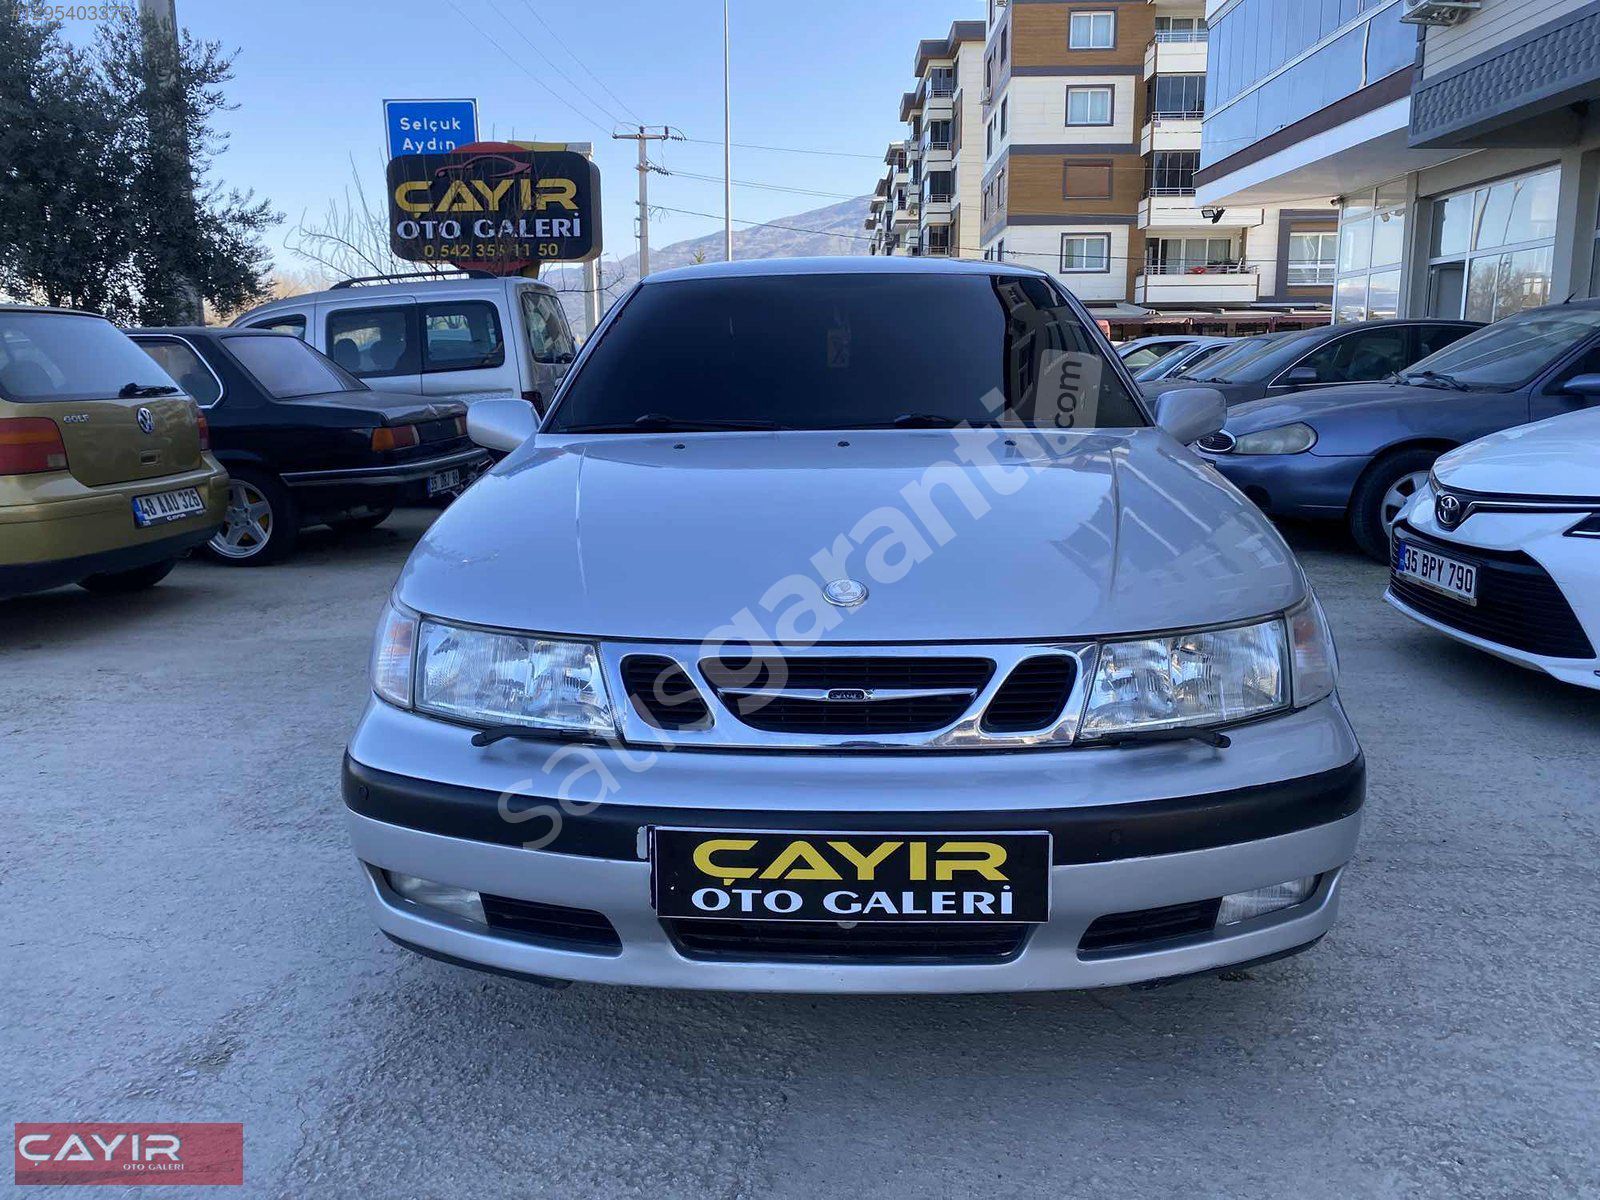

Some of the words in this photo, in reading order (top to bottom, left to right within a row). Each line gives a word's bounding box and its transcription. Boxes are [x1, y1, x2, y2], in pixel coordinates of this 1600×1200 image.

[400, 117, 461, 132] Selçuk
[402, 138, 456, 154] Aydın
[395, 178, 579, 218] ÇAYIR
[396, 219, 461, 239] OTO
[474, 213, 581, 239] GALERİ
[440, 244, 470, 257] 542
[538, 242, 559, 256] 50
[63, 413, 90, 423] GOLF
[139, 497, 157, 517] 48
[178, 489, 200, 509] 326
[1404, 548, 1418, 573] 35
[1421, 554, 1444, 582] BPY
[1448, 563, 1473, 593] 790
[693, 839, 1011, 886] ÇAYIR
[691, 887, 803, 914] OTO
[823, 885, 1013, 915] GALERİ
